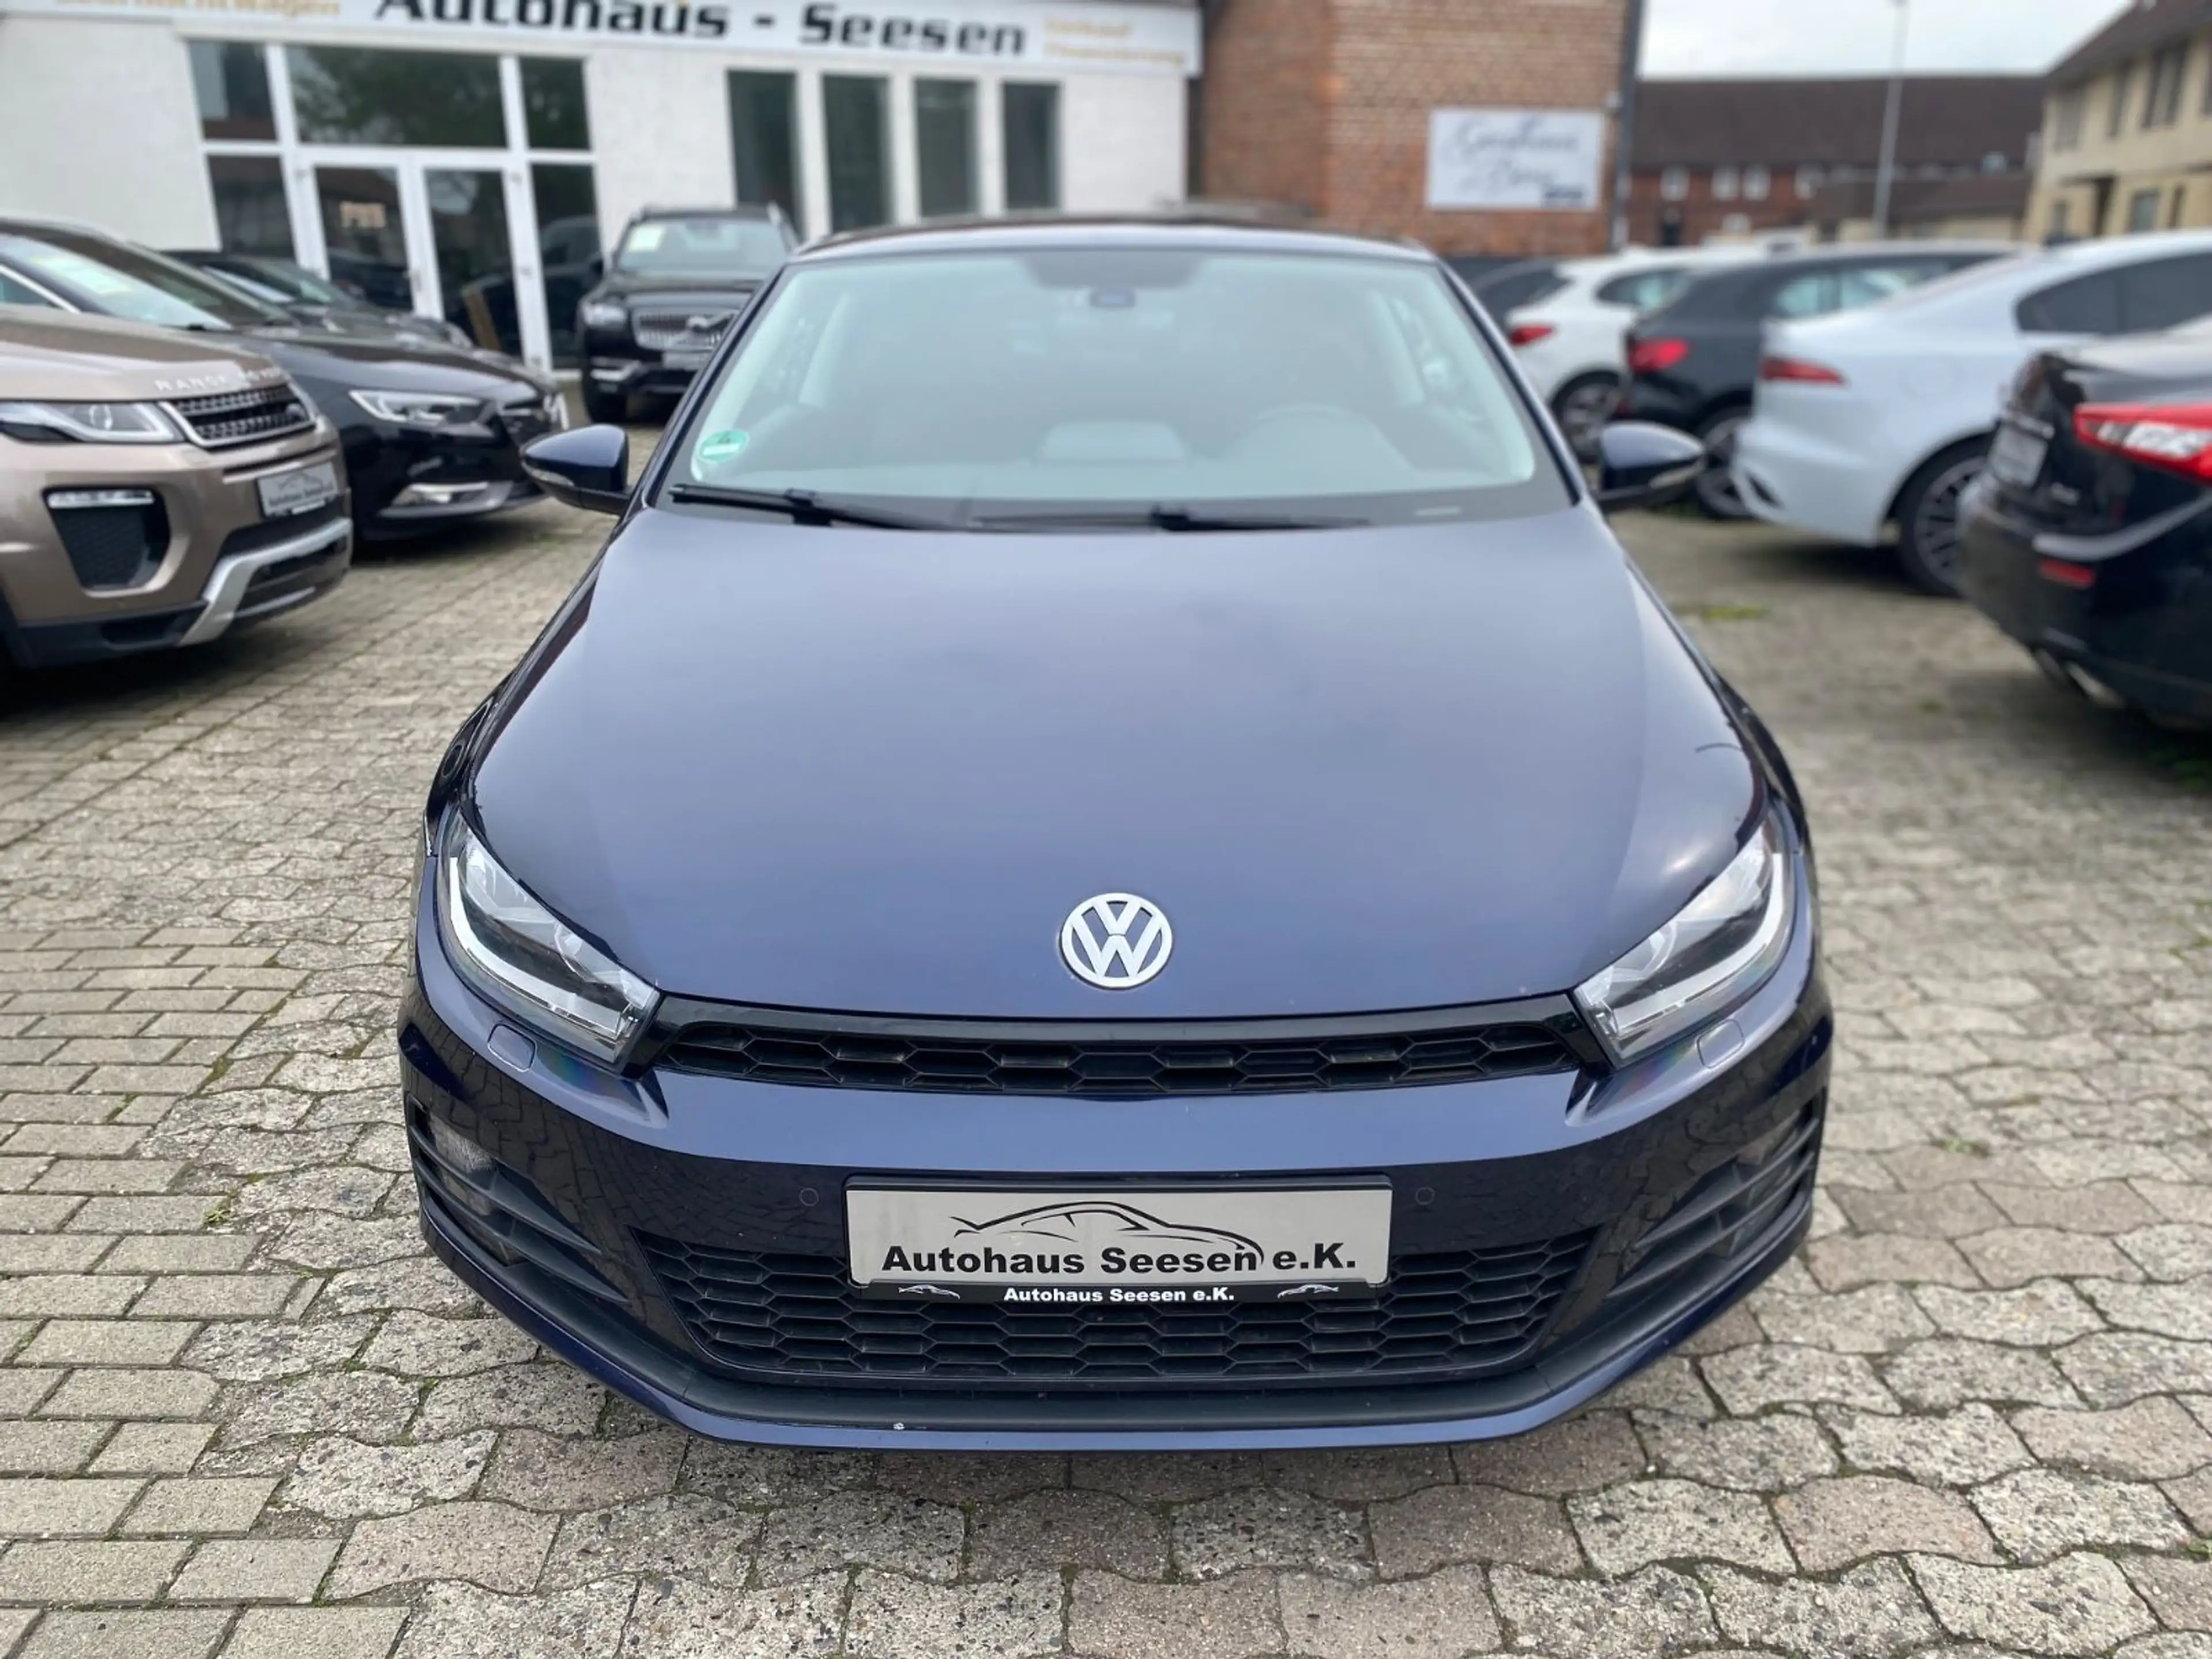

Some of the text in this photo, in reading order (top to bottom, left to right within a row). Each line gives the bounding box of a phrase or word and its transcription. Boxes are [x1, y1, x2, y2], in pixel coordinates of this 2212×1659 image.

[800, 2, 1026, 56] Seesen
[882, 1243, 1357, 1274] Autohaus Seesen e.K.
[1003, 1286, 1234, 1302] Autohaus Seesen e.K.
